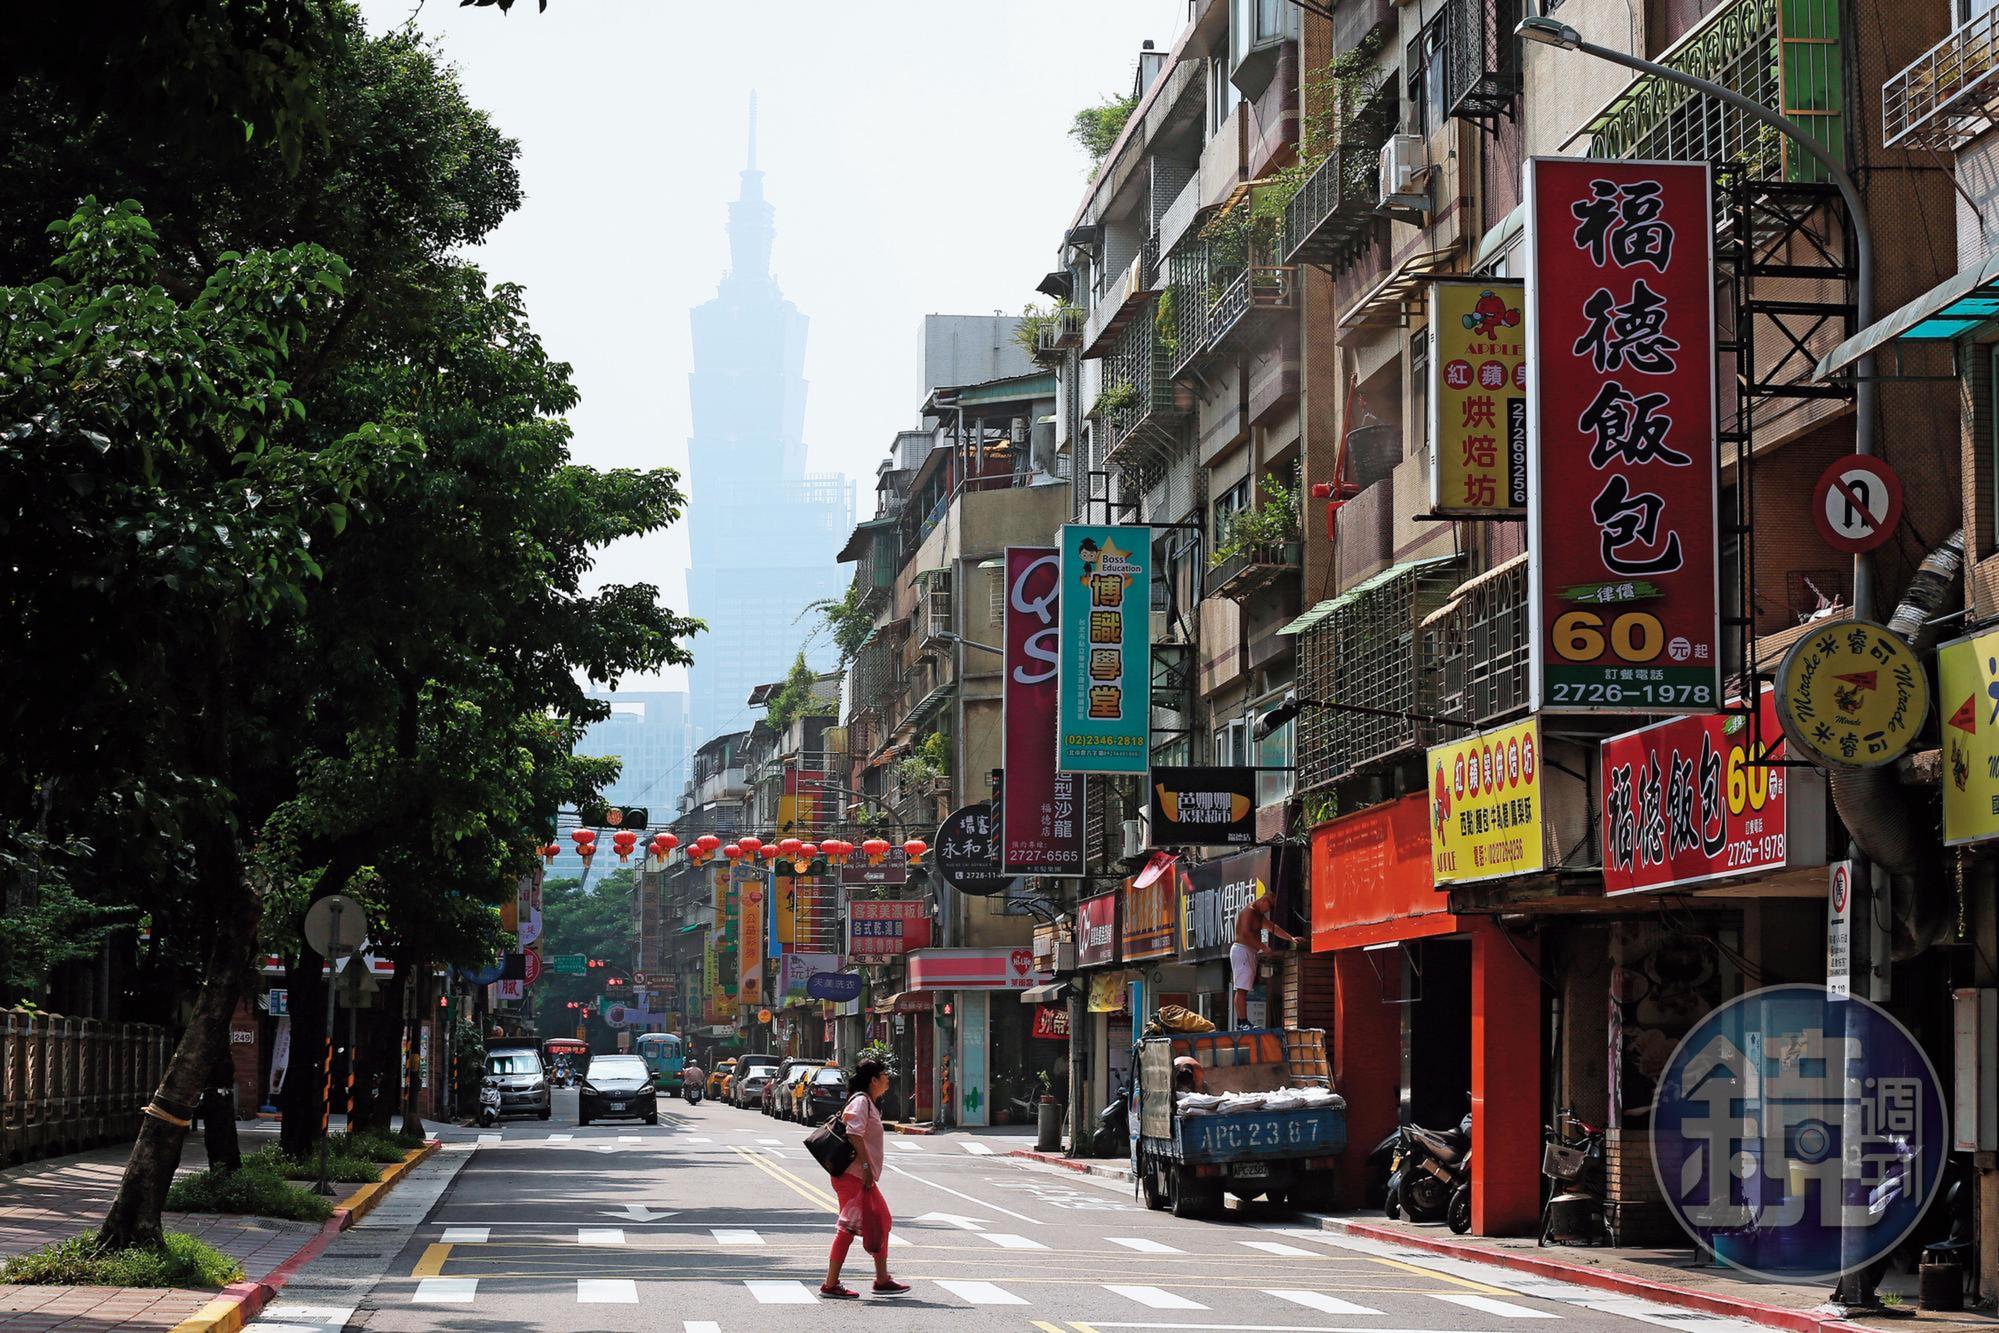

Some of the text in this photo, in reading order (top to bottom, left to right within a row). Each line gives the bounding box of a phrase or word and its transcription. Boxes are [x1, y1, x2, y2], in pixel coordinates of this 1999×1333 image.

[1465, 343, 1523, 356] APPLE
[1571, 178, 1692, 576] 福德飯包
[1462, 396, 1497, 506] 烘焙坊
[1513, 403, 1526, 503] 27269256
[1102, 554, 1124, 564] Boss
[1102, 564, 1141, 572] Education
[1577, 582, 1635, 602] 一律價
[1089, 573, 1122, 718] 博識學堂
[1553, 683, 1710, 704] 2726-1978
[1608, 730, 1727, 873] 福德飯包
[1010, 850, 1078, 862] 2727-6565
[1728, 834, 1784, 867] 2726-1978
[234, 1033, 251, 1041] 249
